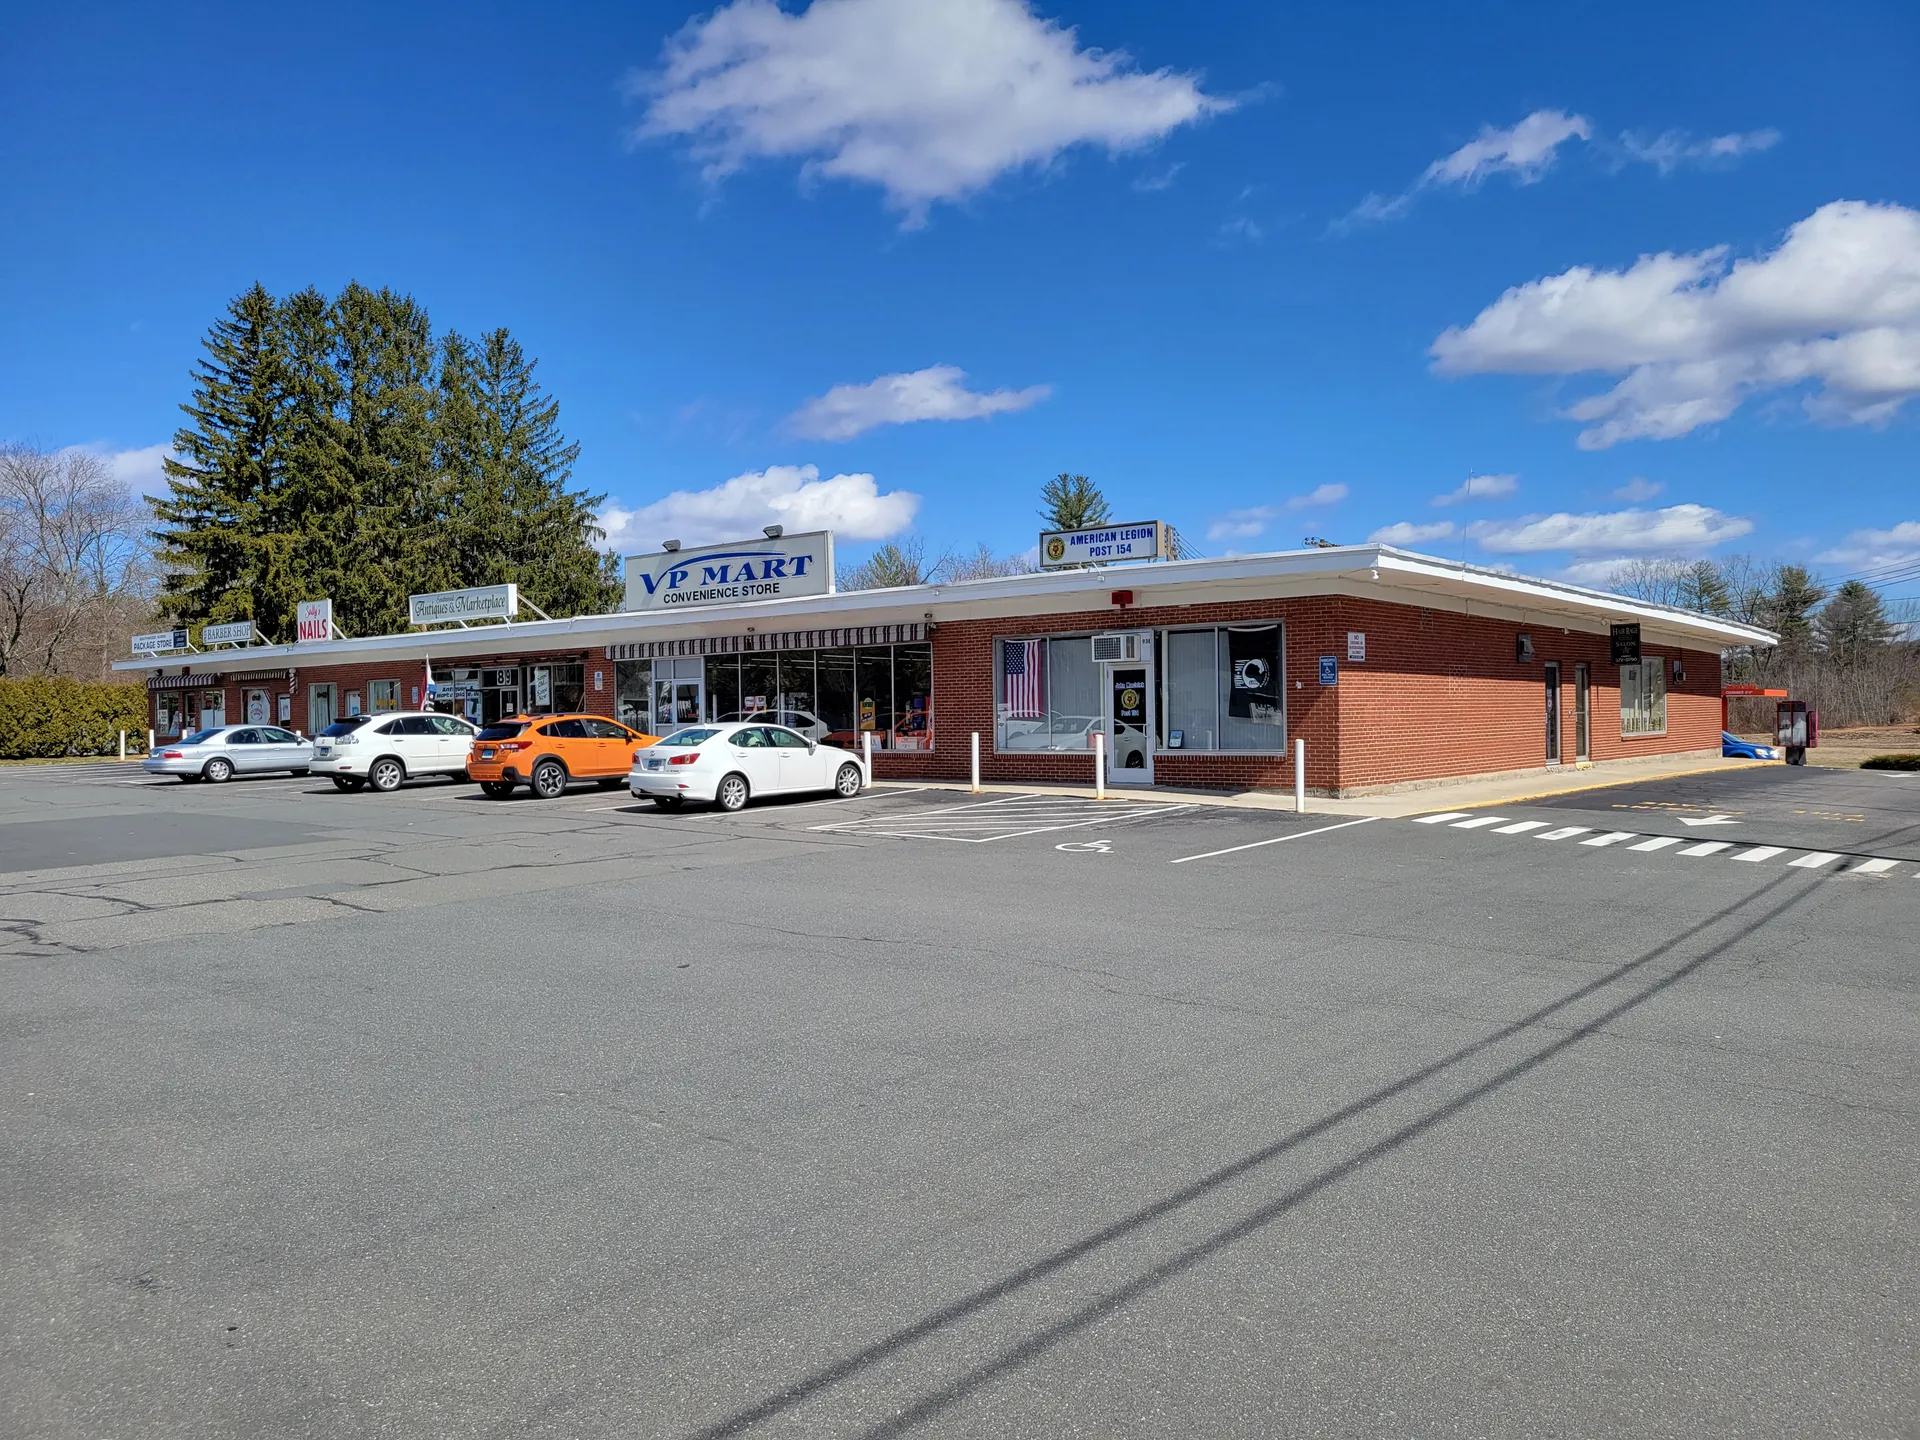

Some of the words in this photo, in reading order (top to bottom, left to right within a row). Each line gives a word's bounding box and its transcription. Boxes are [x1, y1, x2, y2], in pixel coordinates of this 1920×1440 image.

[1070, 532, 1117, 546] AMERICAN
[1120, 527, 1153, 540] LEGION
[1089, 545, 1113, 557] POST
[1116, 543, 1132, 554] 154
[640, 570, 689, 595] VP
[700, 555, 813, 586] MART
[663, 587, 739, 604] CONVENIENCE
[742, 582, 780, 596] STORE
[415, 600, 448, 618] Antiques
[449, 602, 456, 613] &
[455, 594, 506, 614] Marketplace
[207, 627, 232, 640] BARBER
[232, 624, 251, 639] SHOP
[299, 619, 327, 640] NAILS
[133, 641, 155, 651] PACKAGE
[156, 639, 172, 648] STORE
[497, 670, 512, 686] 89
